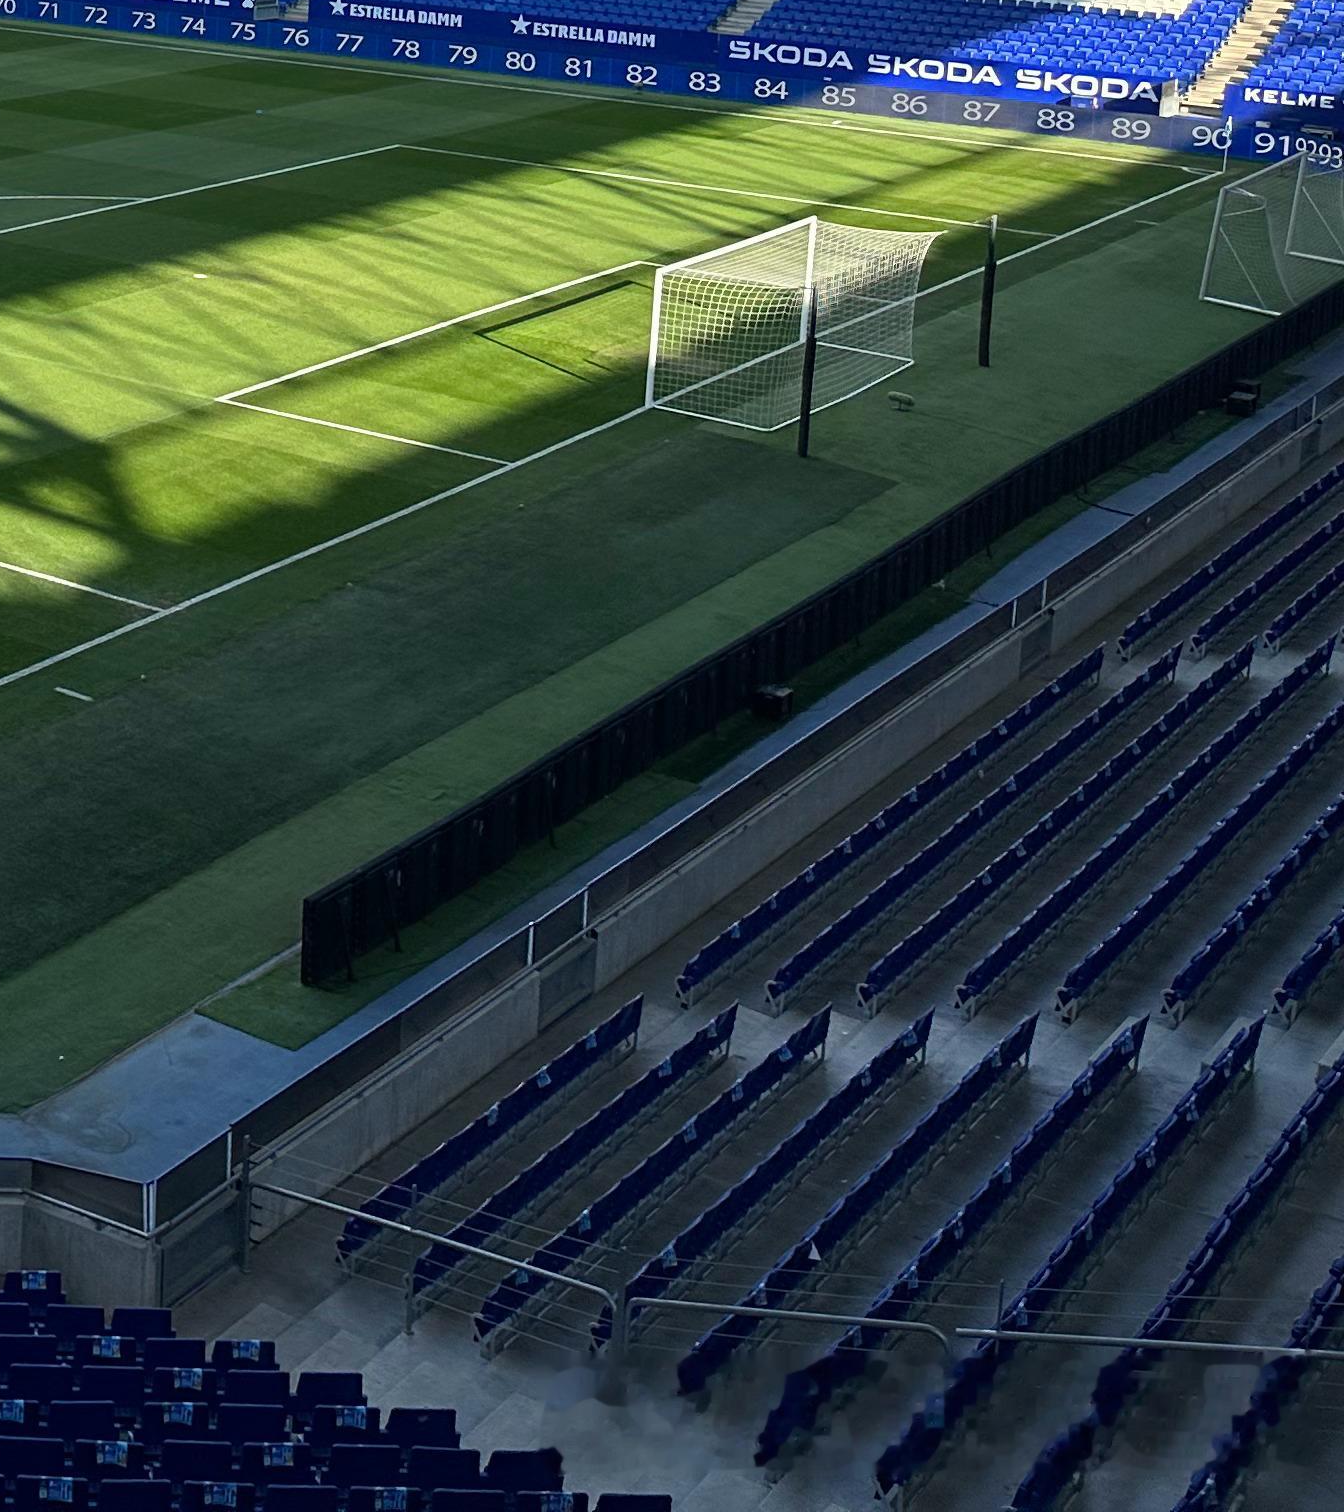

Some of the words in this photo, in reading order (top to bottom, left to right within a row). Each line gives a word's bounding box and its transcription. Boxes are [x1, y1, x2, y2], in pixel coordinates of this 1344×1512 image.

[349, 4, 415, 24] ESTRELLA
[418, 11, 463, 28] DAMM
[532, 22, 604, 43] ESTRELLA
[607, 29, 656, 48] DAMM
[38, 2, 59, 19] 71
[84, 6, 108, 24] 72
[132, 11, 156, 30] 73
[180, 16, 206, 35] 74
[230, 22, 256, 40] 75
[282, 28, 310, 47] 76
[336, 34, 364, 52] 77
[392, 39, 420, 59] 78
[448, 45, 477, 65] 79
[505, 52, 536, 72] 80
[564, 58, 592, 79] 81
[626, 64, 658, 86] 82
[688, 71, 721, 93] 83
[754, 78, 789, 100] 84
[821, 85, 856, 107] 85
[891, 92, 928, 115] 86
[963, 100, 1001, 123] 87
[1037, 108, 1075, 132] 88
[1110, 117, 1151, 141] 89
[1191, 125, 1233, 150] 90
[1254, 132, 1290, 156] 91
[1296, 137, 1317, 162] 92
[1318, 143, 1343, 168] 93
[1244, 87, 1335, 110] KELME
